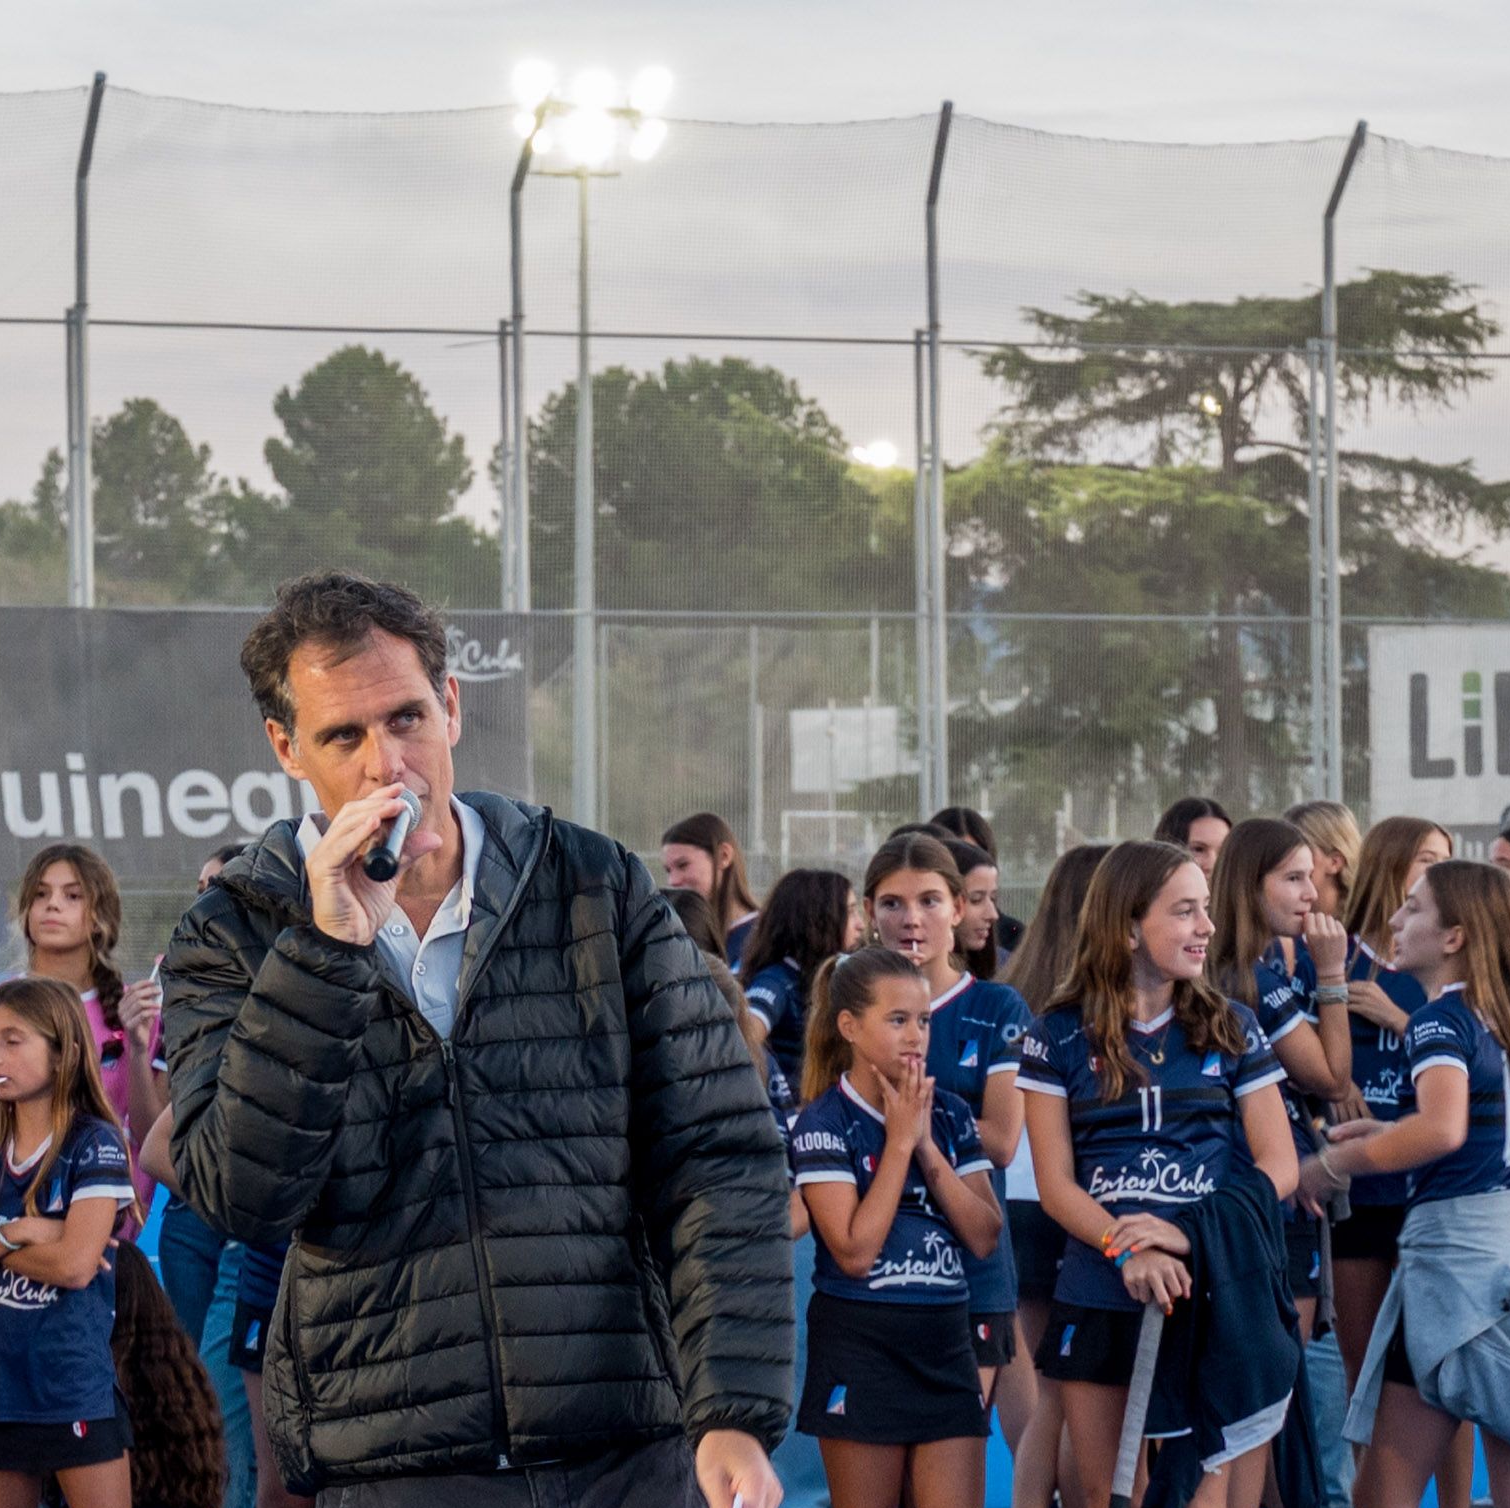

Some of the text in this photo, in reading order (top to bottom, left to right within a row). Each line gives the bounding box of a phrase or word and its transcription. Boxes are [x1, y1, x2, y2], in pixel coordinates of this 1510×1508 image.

[1138, 1086, 1162, 1132] 11
[1089, 1163, 1216, 1195] Enjoy Cuba
[12, 1275, 58, 1302] Cuba
